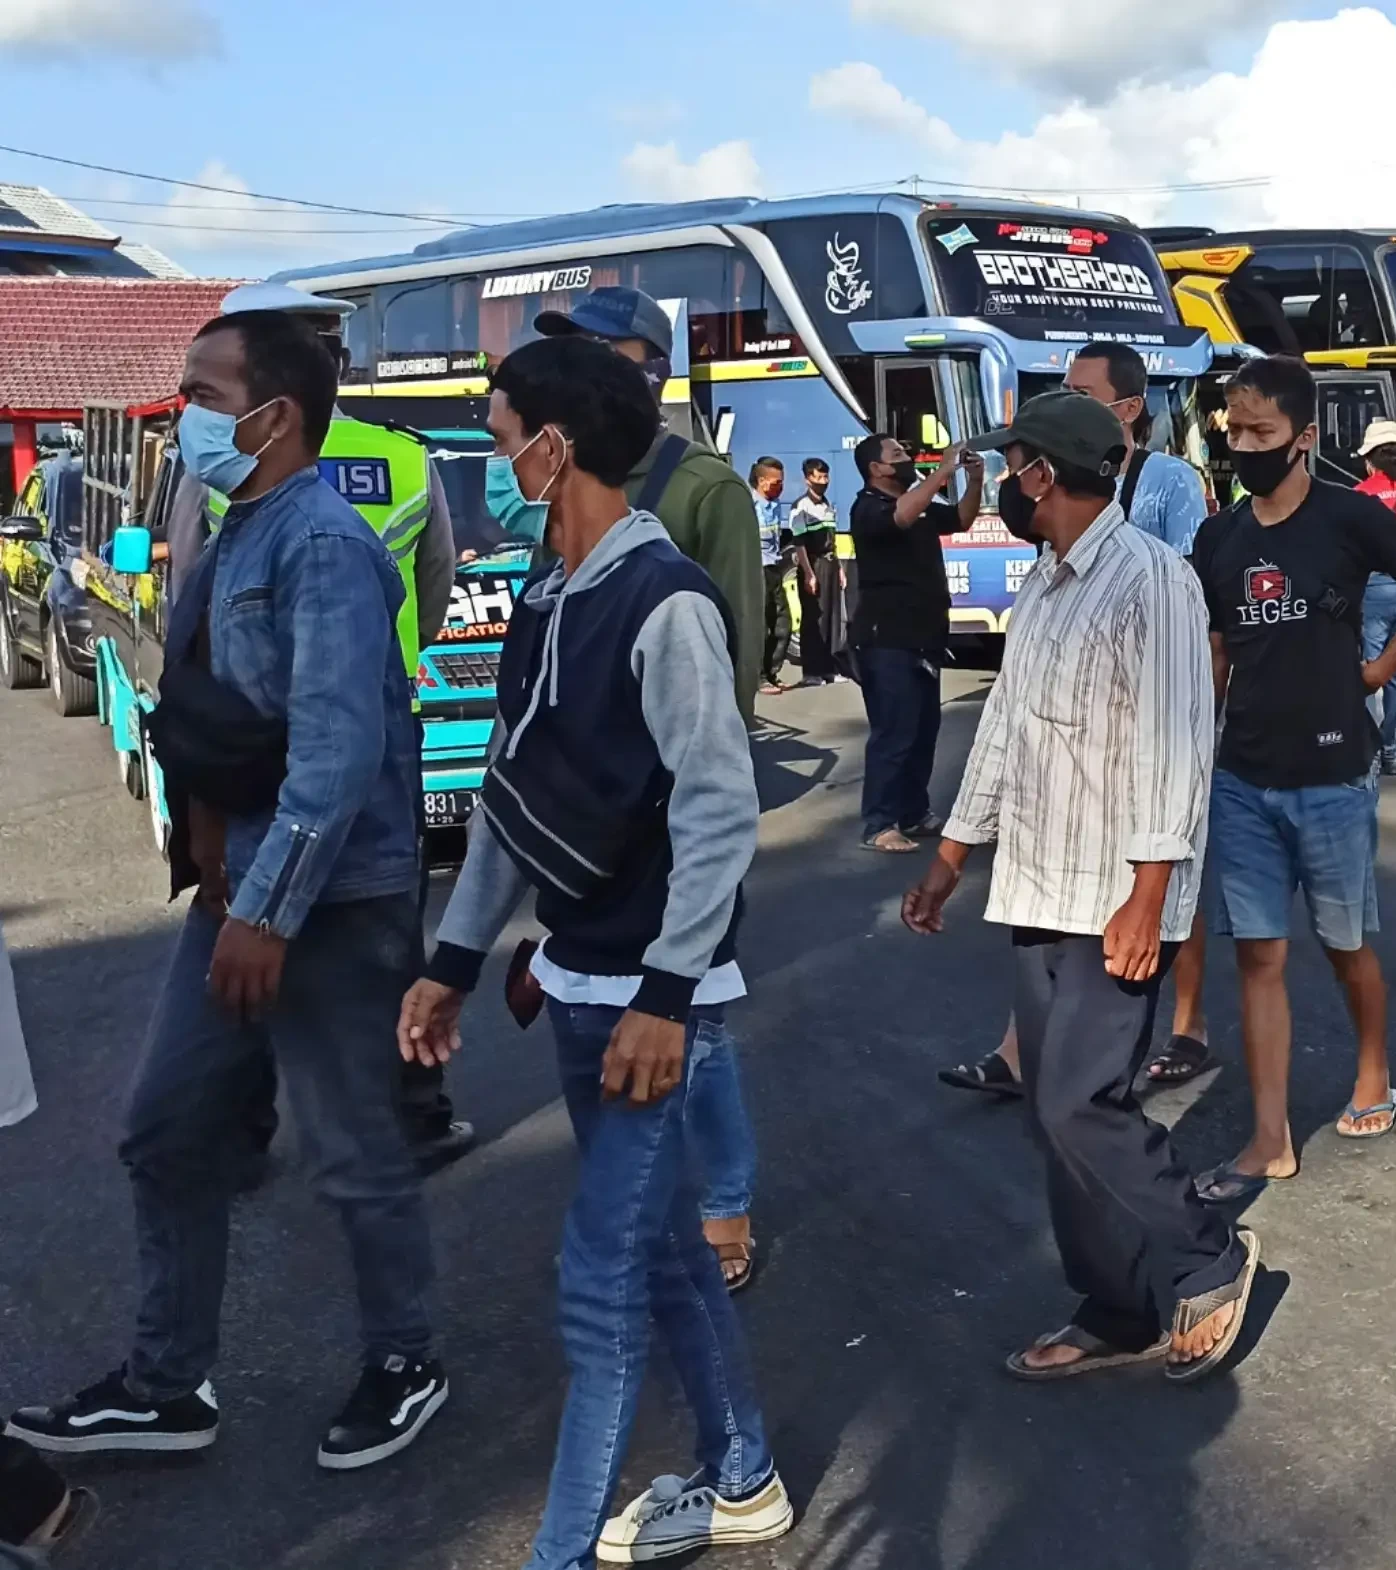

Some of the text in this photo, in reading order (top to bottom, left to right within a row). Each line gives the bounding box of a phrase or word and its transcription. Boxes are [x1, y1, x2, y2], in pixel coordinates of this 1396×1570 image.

[338, 465, 386, 495] ISI
[946, 560, 970, 577] UK
[948, 577, 970, 594] US
[1236, 599, 1308, 624] TEGEG
[436, 622, 509, 641] FICATIO
